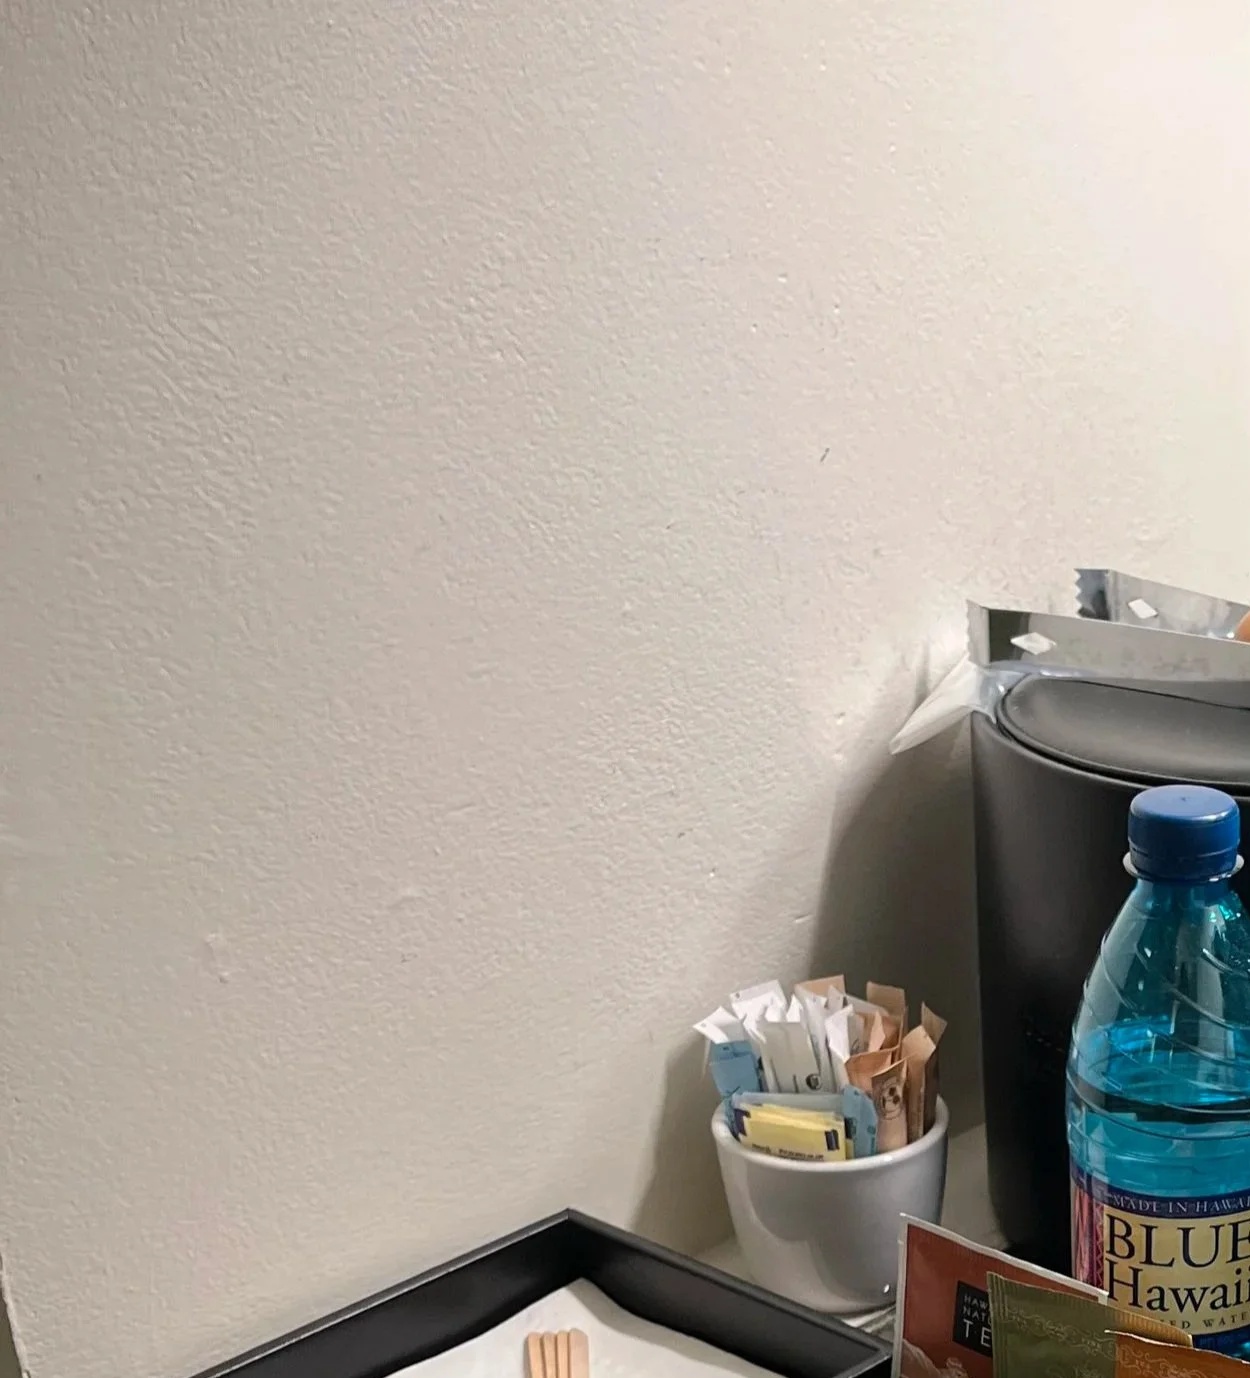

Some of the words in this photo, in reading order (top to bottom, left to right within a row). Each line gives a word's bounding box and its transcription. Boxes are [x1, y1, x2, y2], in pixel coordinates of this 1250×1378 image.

[1112, 1195, 1162, 1213] MADE
[1168, 1202, 1188, 1213] IN
[963, 1319, 992, 1348] TE
